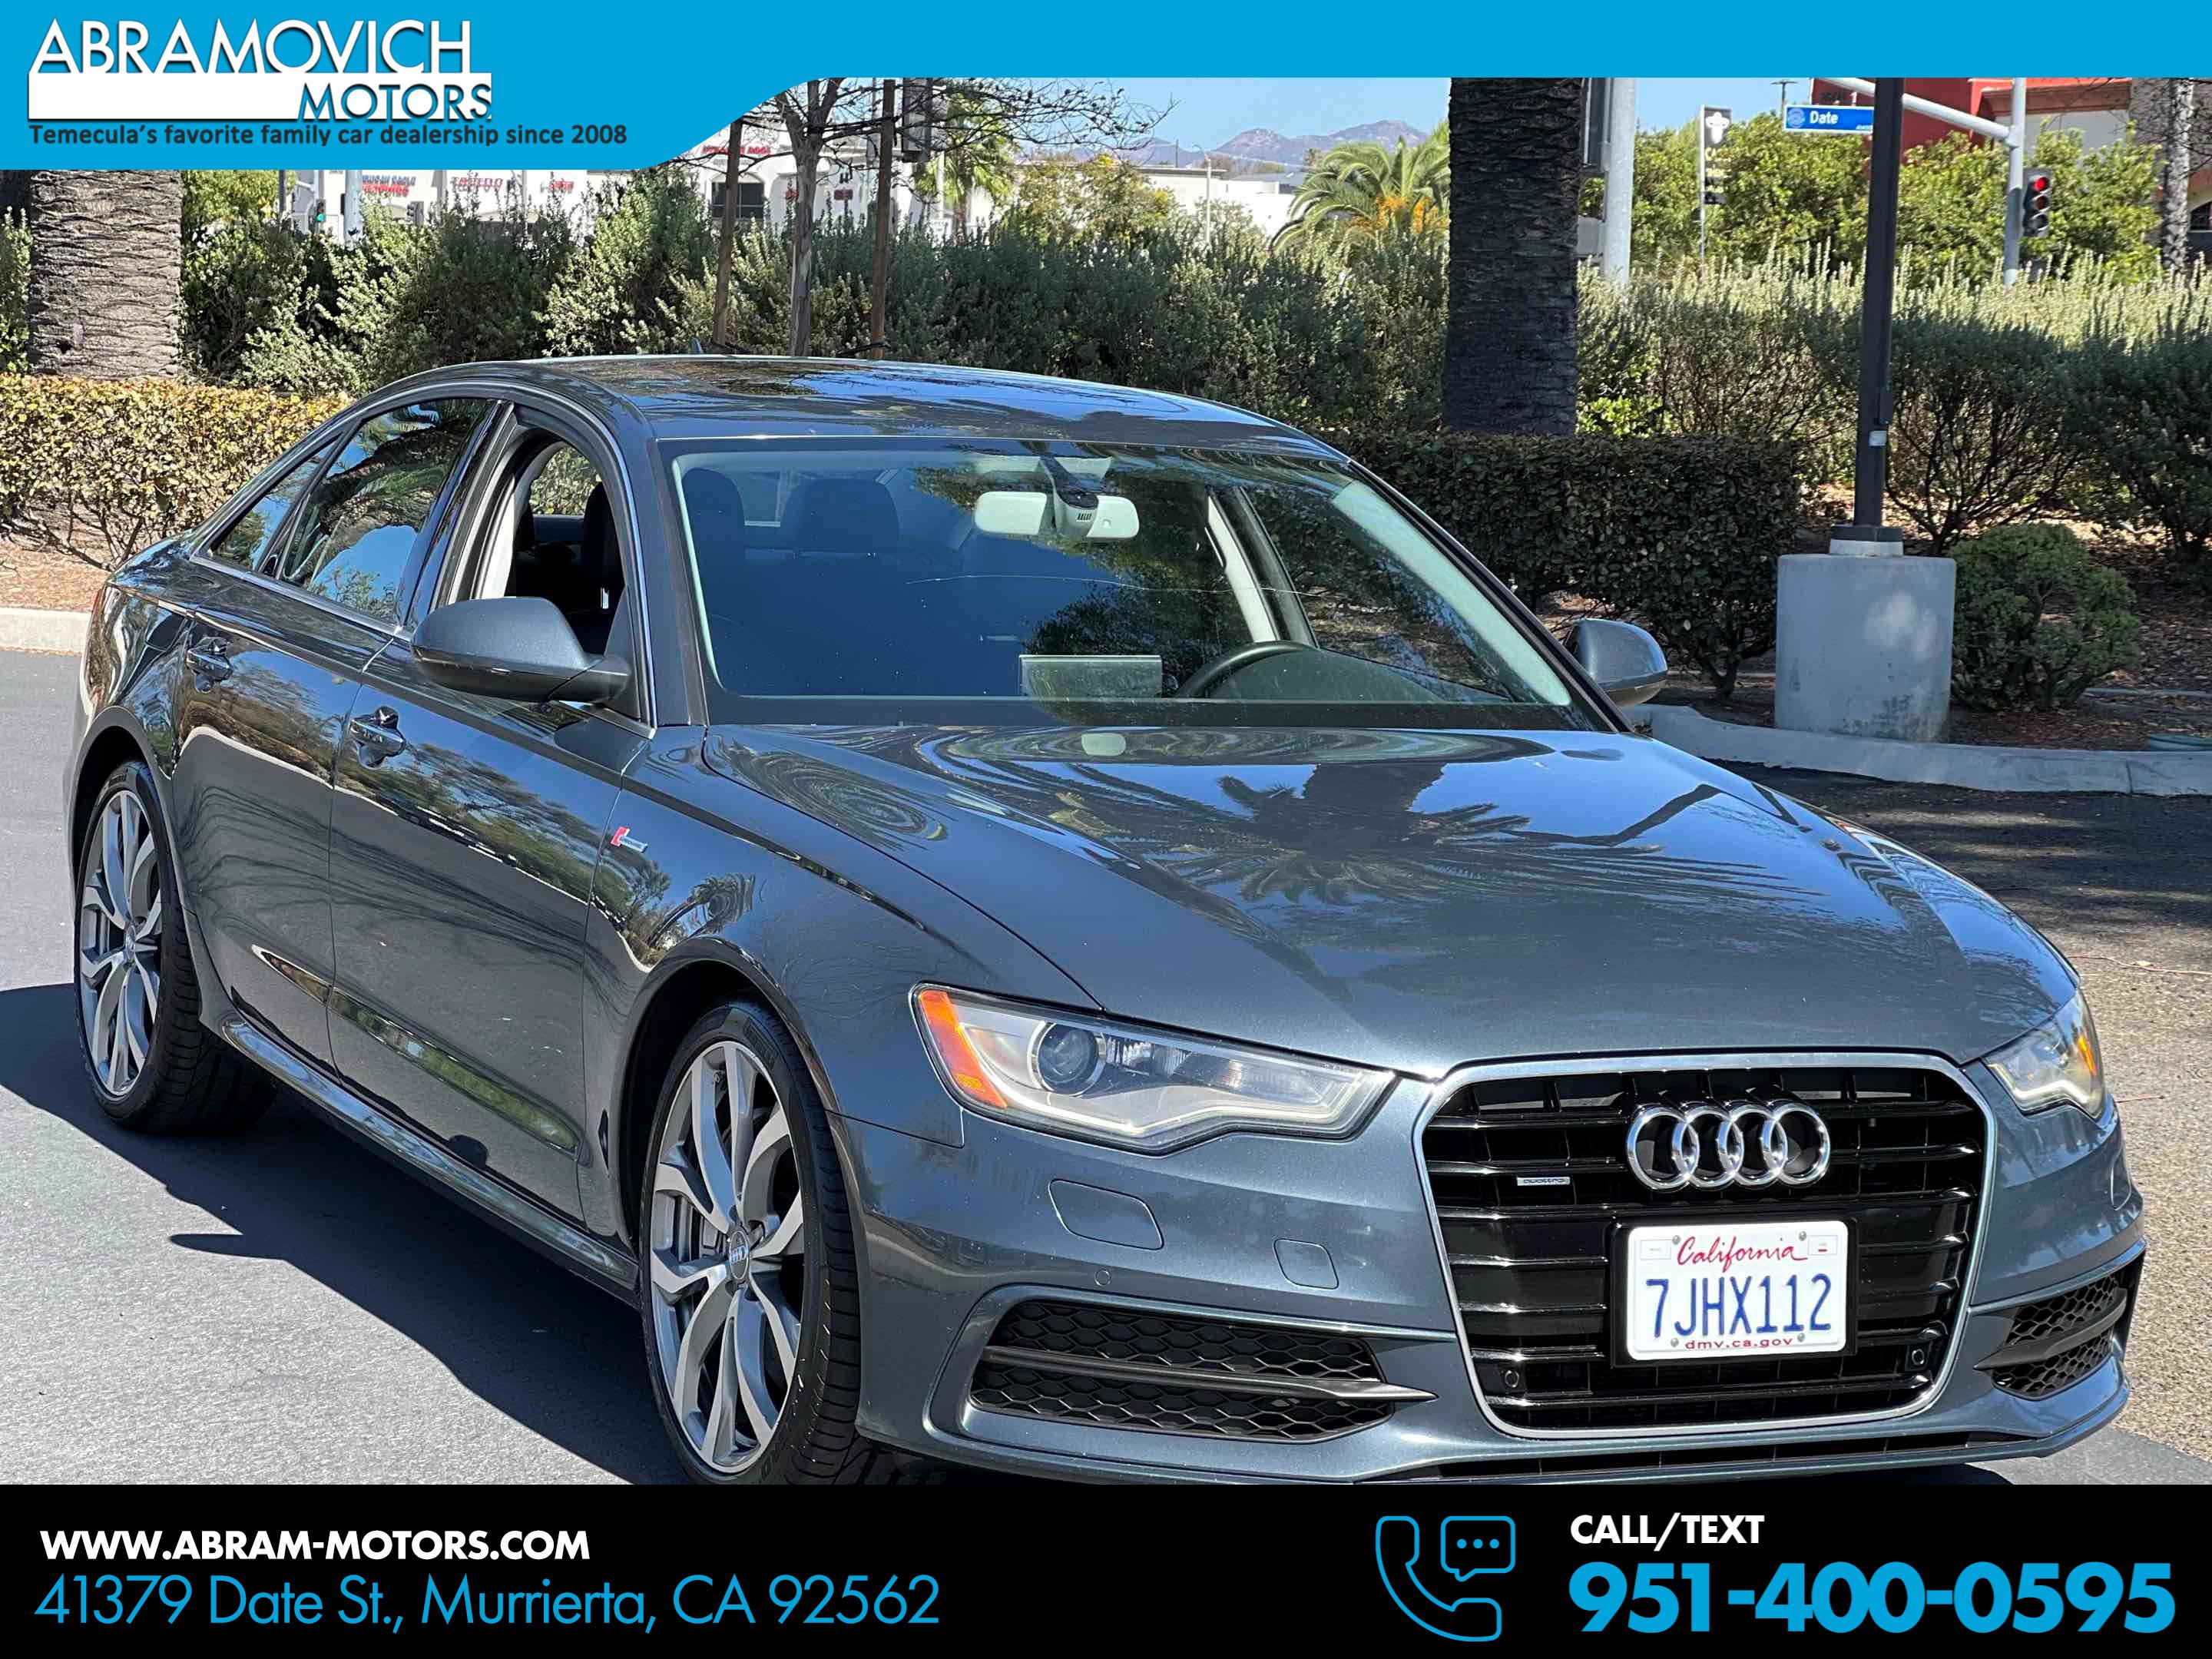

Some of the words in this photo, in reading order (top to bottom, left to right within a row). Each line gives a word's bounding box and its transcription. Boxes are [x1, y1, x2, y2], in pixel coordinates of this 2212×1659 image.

[1810, 111, 1839, 124] Date
[1676, 1236, 1809, 1272] California
[1645, 1272, 1833, 1339] 7JHX112
[1684, 1337, 1793, 1350] dmv.ca.gov
